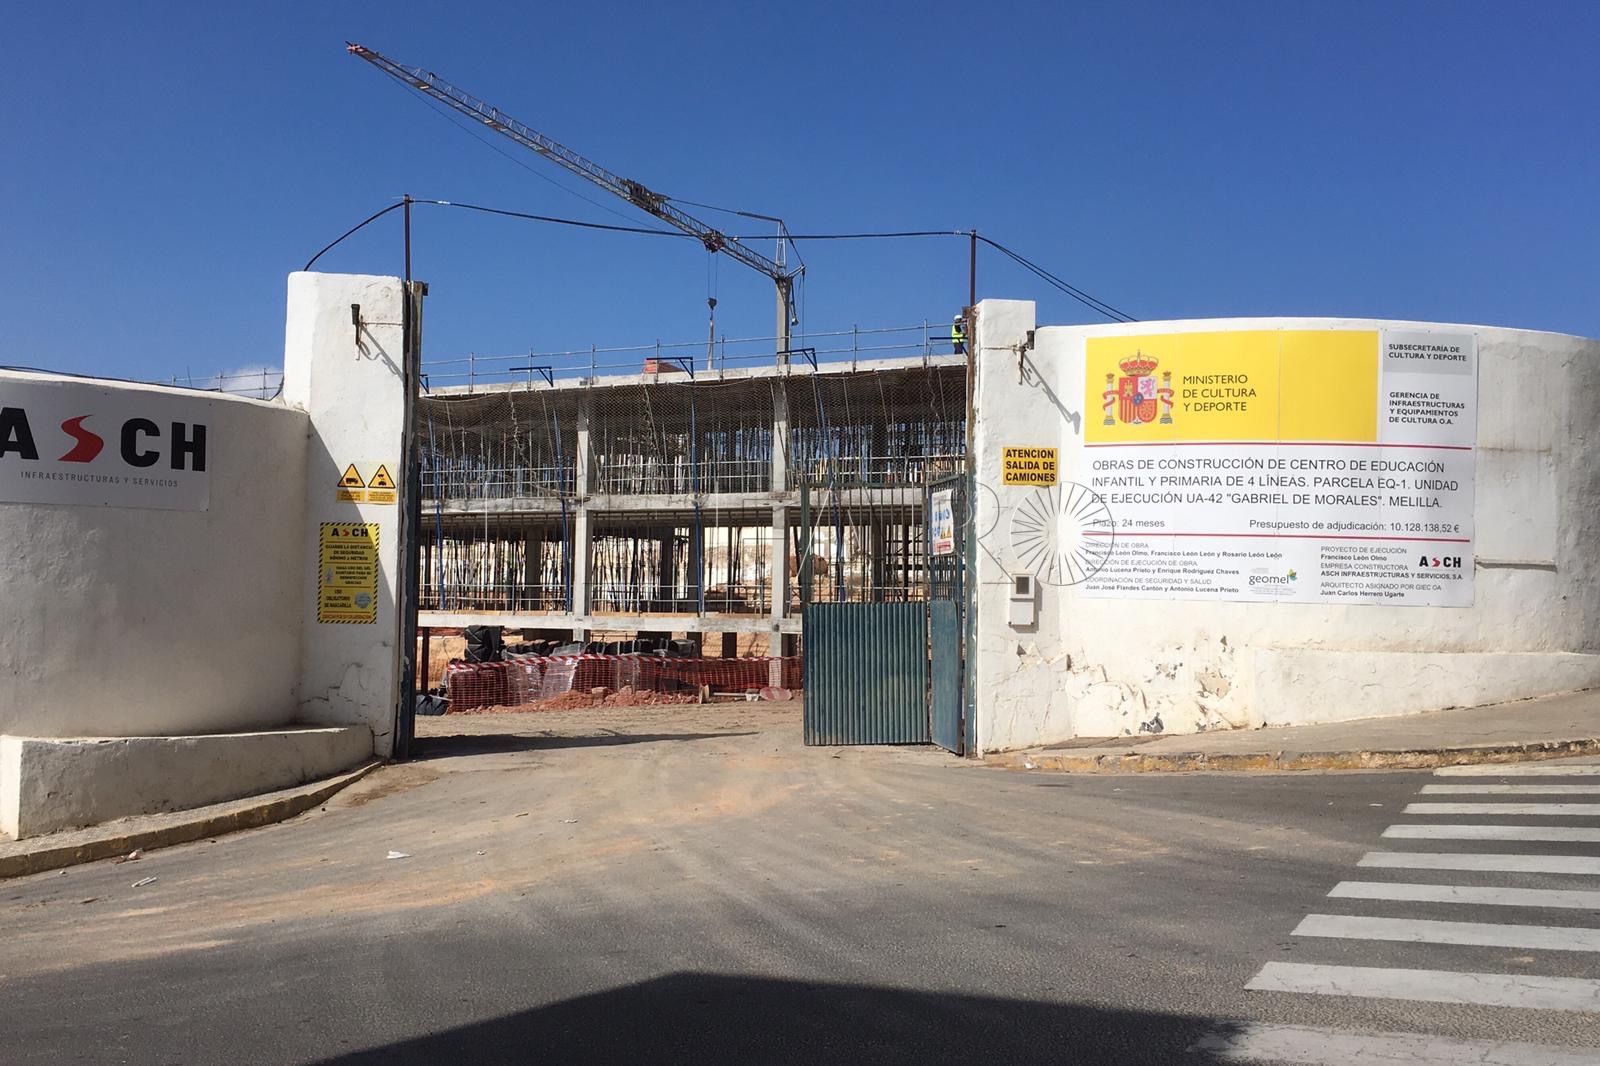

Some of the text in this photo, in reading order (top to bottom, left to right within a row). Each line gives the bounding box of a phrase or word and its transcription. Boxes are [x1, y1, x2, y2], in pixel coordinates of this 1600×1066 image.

[1388, 343, 1449, 352] SUBSECRETARÍA
[1183, 374, 1248, 385] MINISTERIO
[1183, 387, 1257, 399] DE CULTURA
[1389, 391, 1428, 399] GERENCIA
[1183, 401, 1247, 412] Y DEPORTE
[1389, 400, 1465, 409] INFRAESTRUCTURAS
[1396, 408, 1459, 417] EQUIPAMIENTOS
[1005, 449, 1054, 459] ATENCION
[1005, 461, 1055, 471] SALIDA DE
[1092, 457, 1445, 473] OBRAS DE CONSTRUCCIÓN DE CENTRO DE EDUCACIÓN
[21, 471, 178, 487] INFRAESTRUCTURAS Y SERVICIOS
[1005, 472, 1055, 482] CAMIONES
[1092, 474, 1459, 491] INFANTIL Y PRIMARIA DE 4 LÍNEAS. PARCELA EQ-1. UNIDAD
[1091, 491, 1442, 508] DE EJECUCIÓN UA-42 "GABRIEL DE MORALES". MELILLA.
[1092, 519, 1165, 528] Plazo: 24 meses
[1249, 519, 1460, 533] Presupuesto de adjudicación: 10.128.138,52 €
[331, 528, 368, 537] ASCH
[1320, 545, 1357, 553] PROYECTO
[1370, 546, 1407, 554] EJECUCIÓN
[1320, 553, 1352, 561] Francisco
[1419, 556, 1462, 568] ASCH
[1320, 562, 1409, 571] EMPRESA CONSTRUCTORA
[1248, 574, 1290, 586] geomel
[1341, 571, 1410, 579] INFRAESTRUCTURAS
